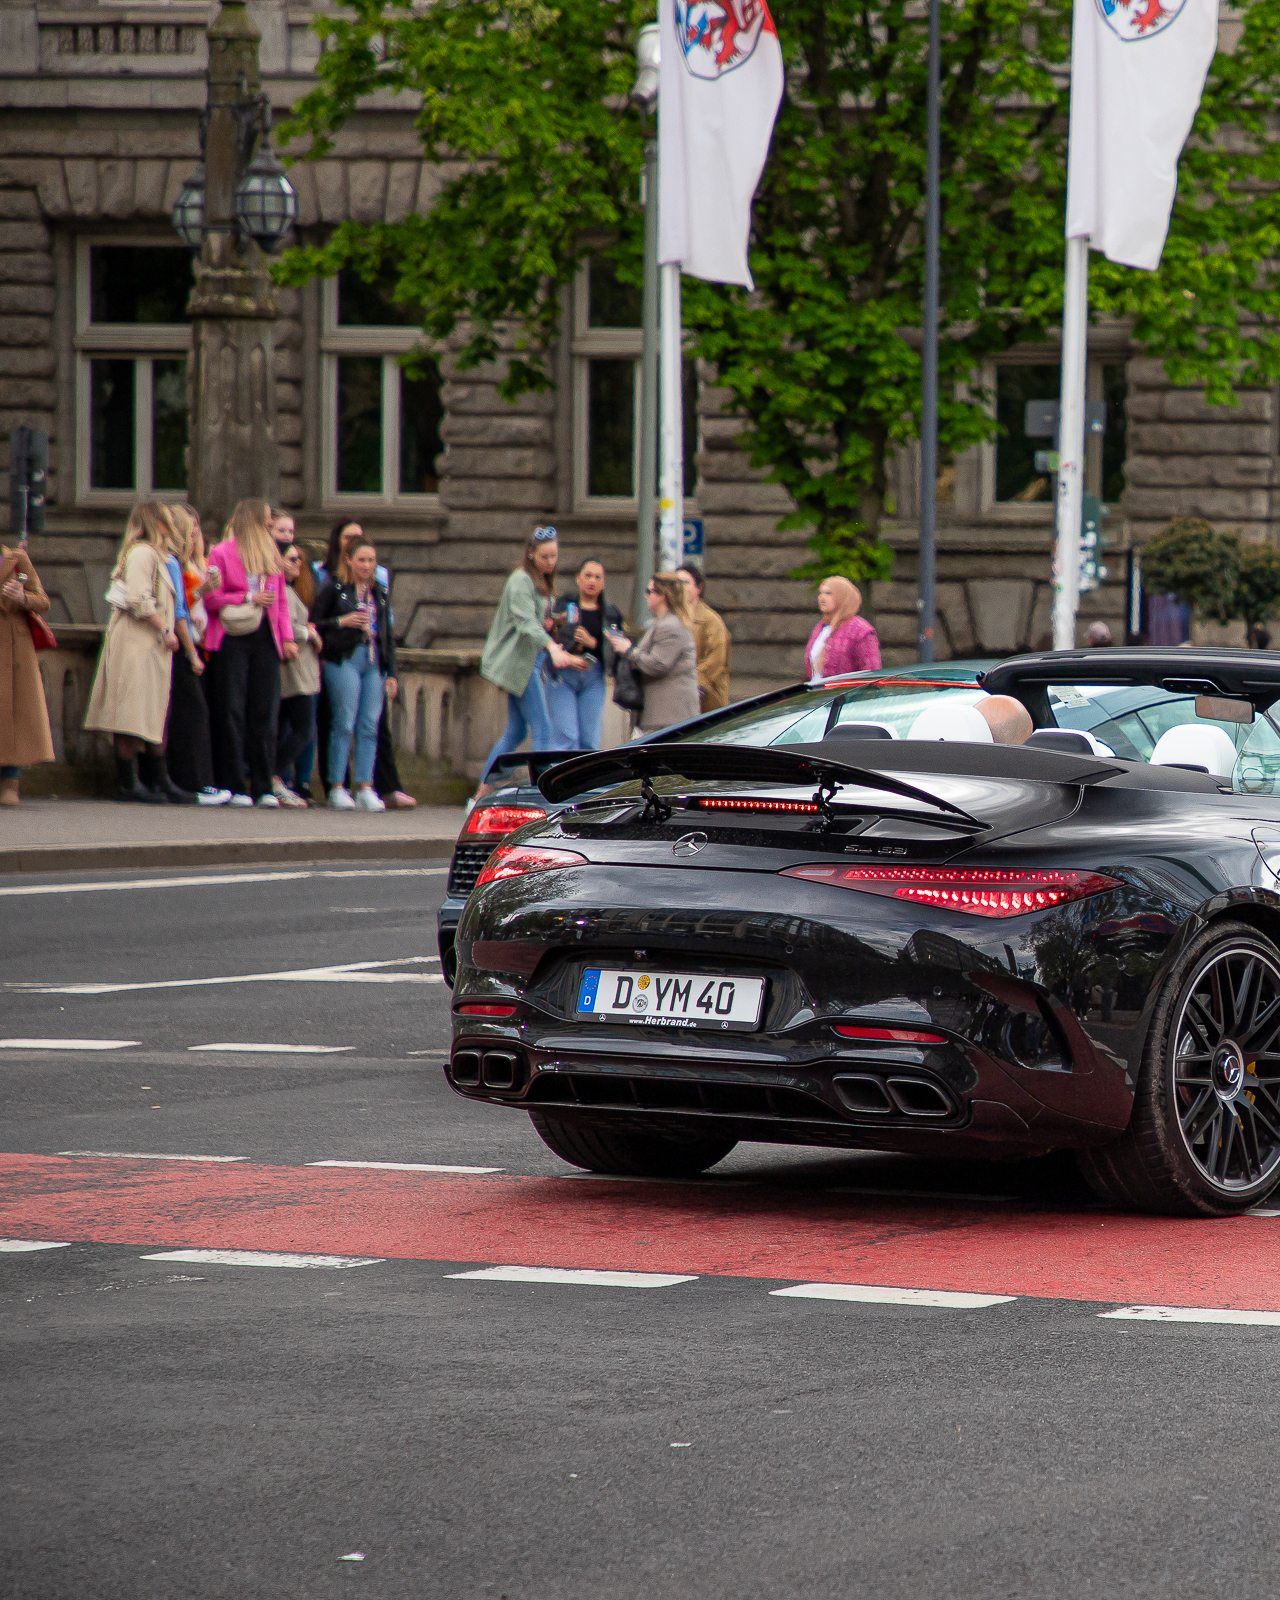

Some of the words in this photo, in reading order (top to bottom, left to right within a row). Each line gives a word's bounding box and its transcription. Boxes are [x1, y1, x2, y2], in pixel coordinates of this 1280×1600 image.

[612, 975, 634, 1009] D
[655, 977, 693, 1013] YM
[696, 980, 735, 1015] 40
[628, 1015, 698, 1028] www.Herbrand.de
